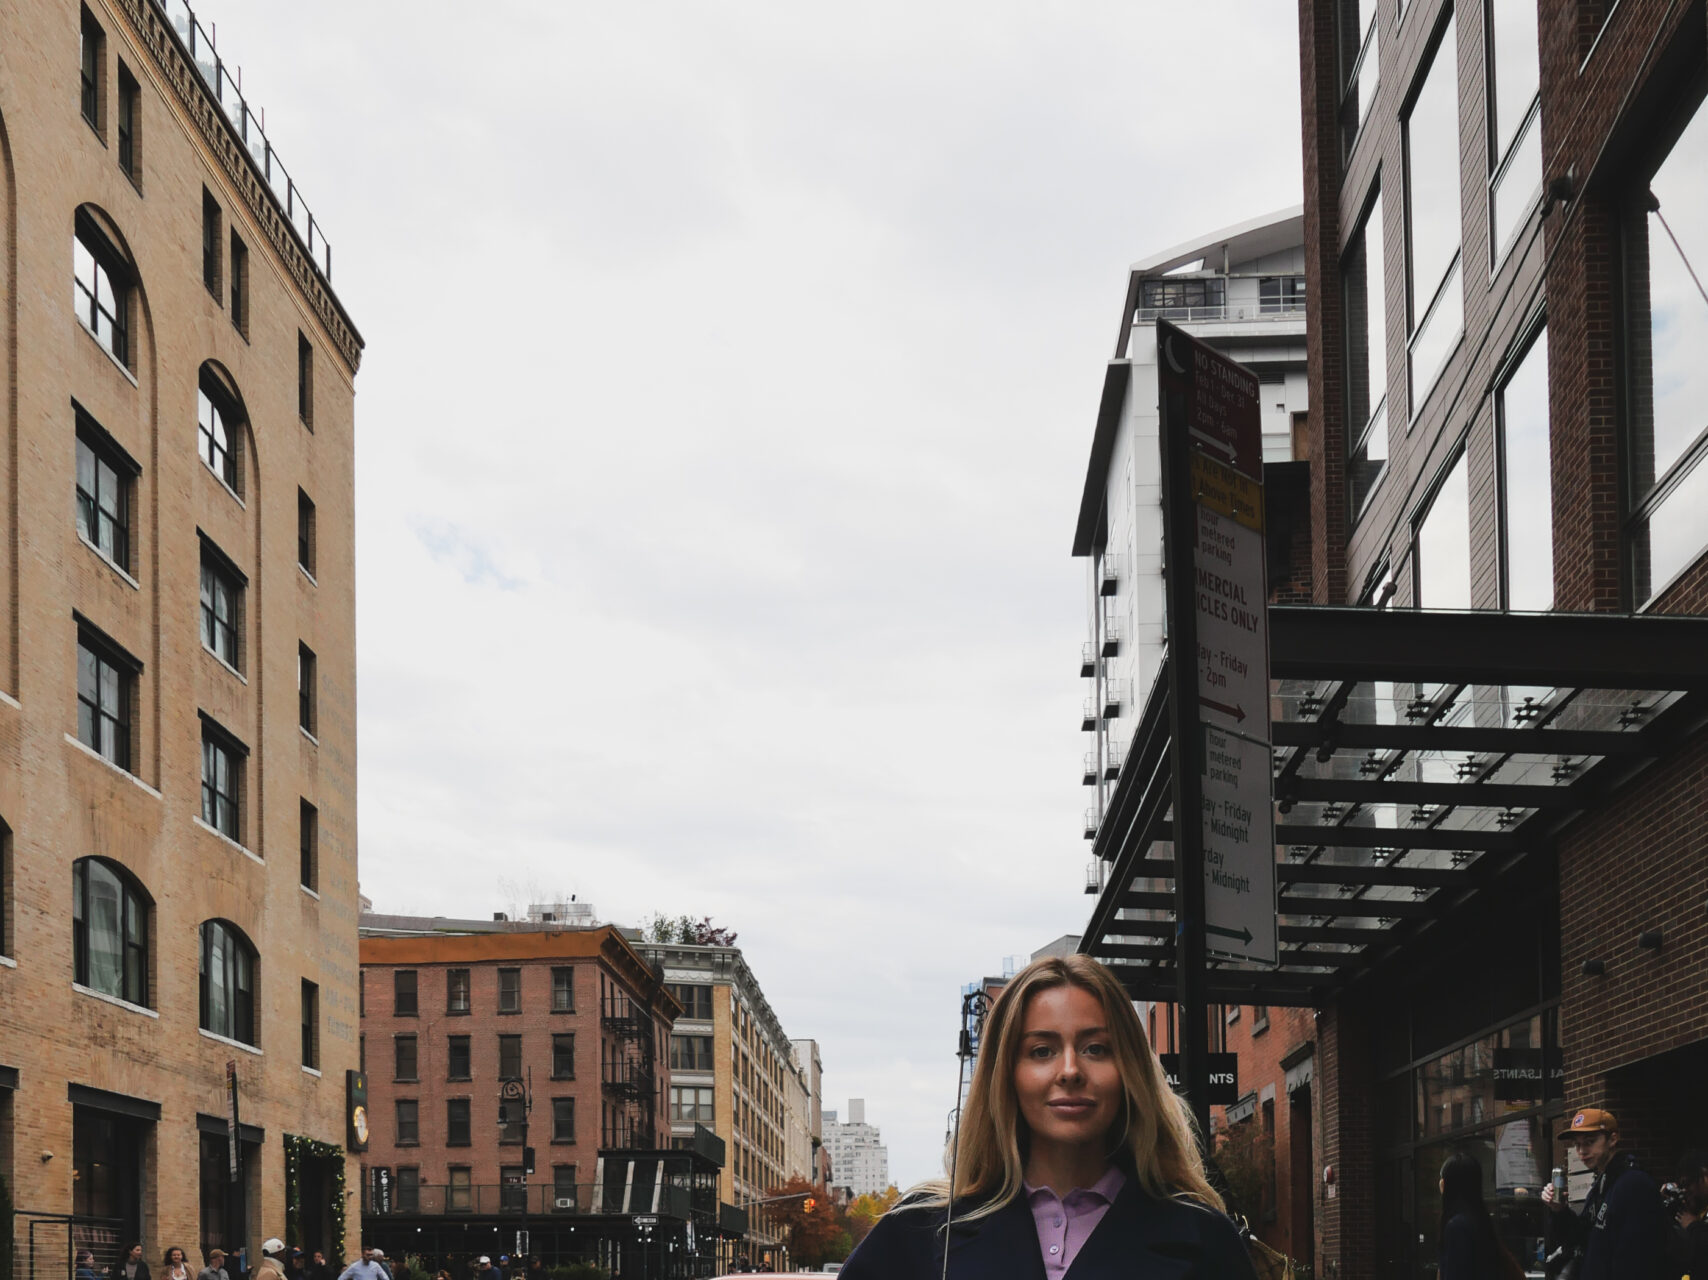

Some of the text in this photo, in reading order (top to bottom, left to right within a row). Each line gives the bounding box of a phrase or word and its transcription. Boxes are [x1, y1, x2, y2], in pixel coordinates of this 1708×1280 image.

[1195, 349, 1255, 398] NO STANDING
[1197, 389, 1228, 417] All Days
[1201, 508, 1218, 526] hour
[1201, 525, 1235, 550] metered
[1202, 541, 1232, 567] parking
[1196, 567, 1247, 606] MERCIAL
[1197, 592, 1258, 633] ICLES ONLY
[1206, 665, 1227, 688] 2pm
[1220, 650, 1248, 679] Friday
[1209, 749, 1242, 770] metered
[1210, 767, 1238, 790] parking
[1200, 793, 1216, 817] day
[1224, 800, 1252, 826] Friday
[1211, 817, 1249, 844] Midnight
[1203, 847, 1224, 869] rday
[1212, 868, 1250, 894] Midnight
